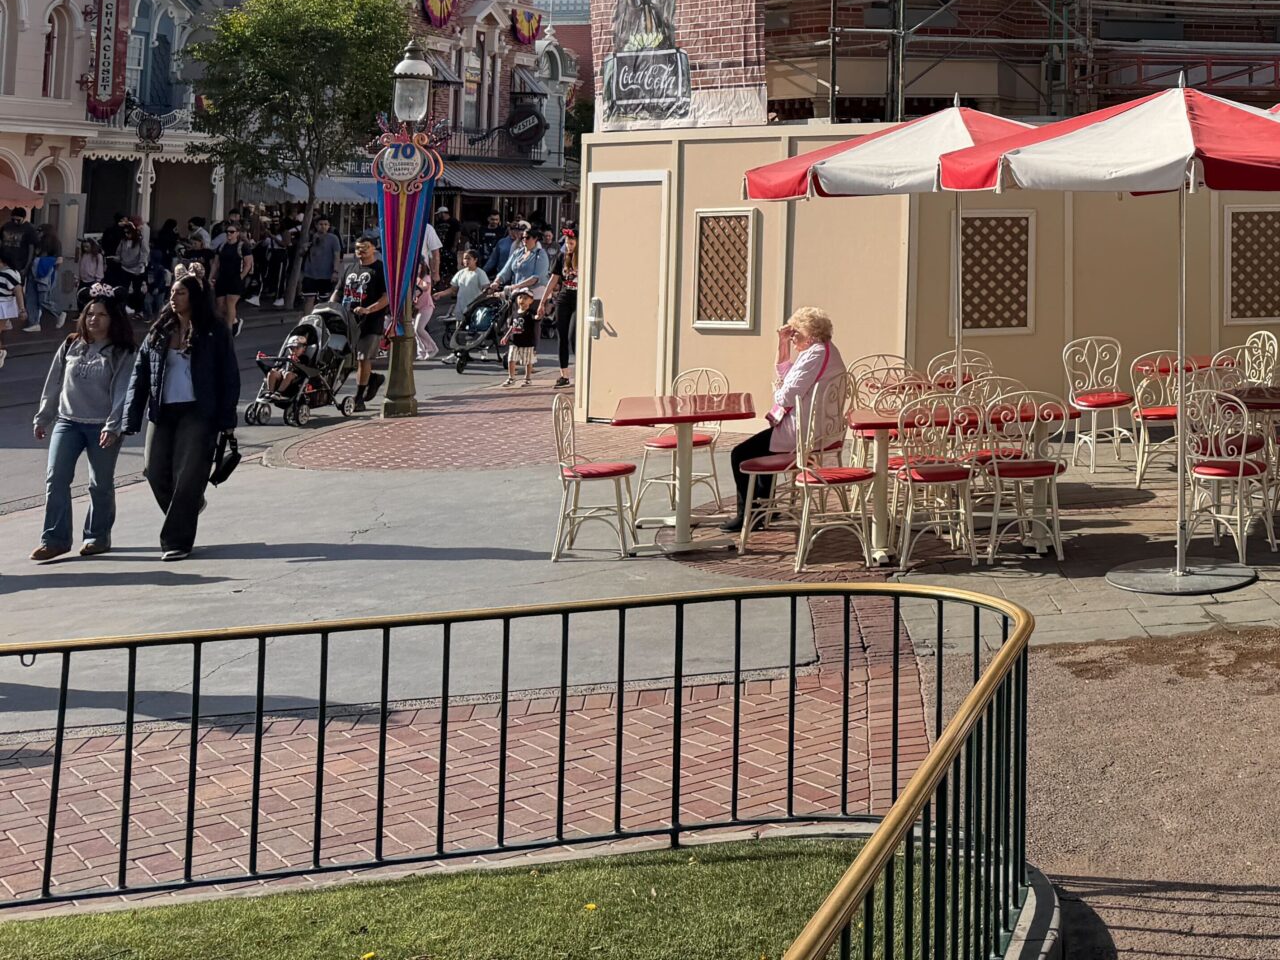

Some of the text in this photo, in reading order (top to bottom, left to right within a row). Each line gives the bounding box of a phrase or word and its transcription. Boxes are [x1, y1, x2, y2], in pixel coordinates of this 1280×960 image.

[100, 2, 114, 91] CHINA CLOSET
[390, 144, 415, 159] 70
